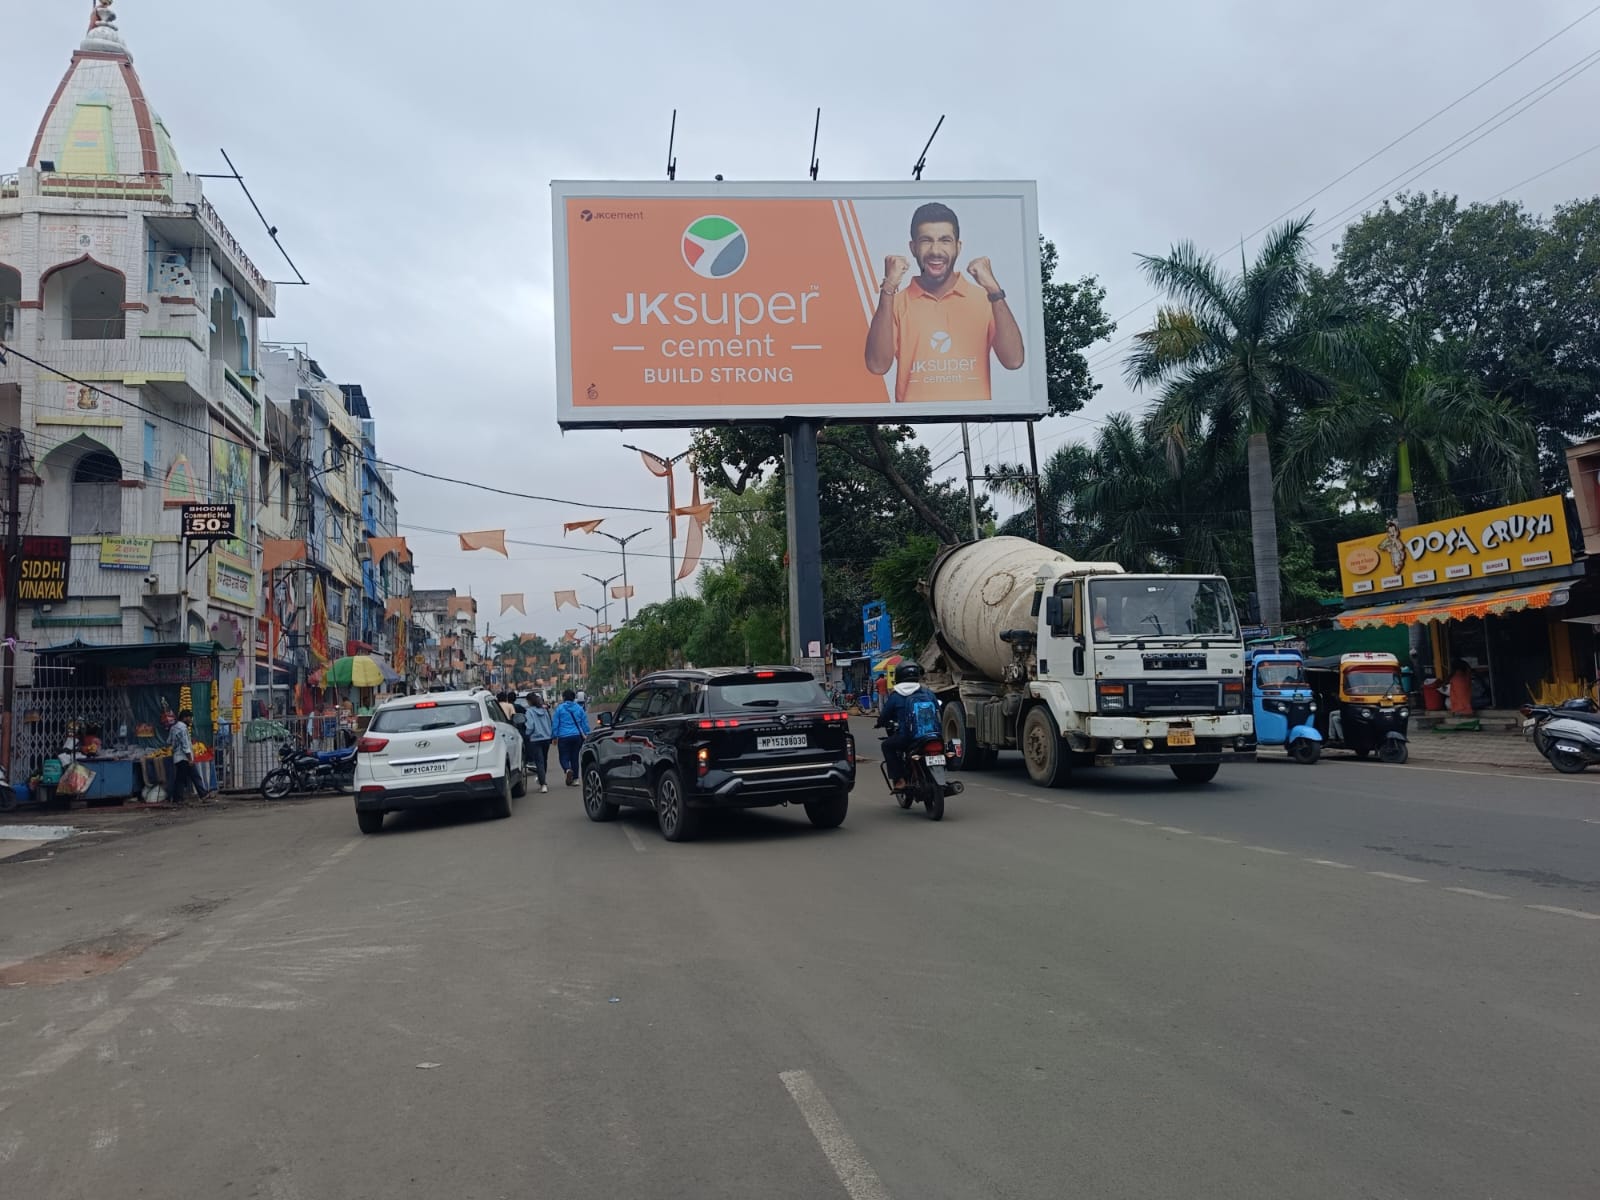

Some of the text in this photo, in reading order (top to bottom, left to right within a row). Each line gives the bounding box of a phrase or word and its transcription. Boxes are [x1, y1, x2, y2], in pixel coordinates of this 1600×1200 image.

[661, 333, 775, 357] cement
[644, 367, 793, 384] BUILD STRONG
[191, 518, 221, 531] 50
[217, 511, 232, 519] Hub
[1405, 514, 1553, 561] DOSA CRUSH
[21, 560, 66, 579] SIDDHI
[18, 580, 65, 599] VINAYAK
